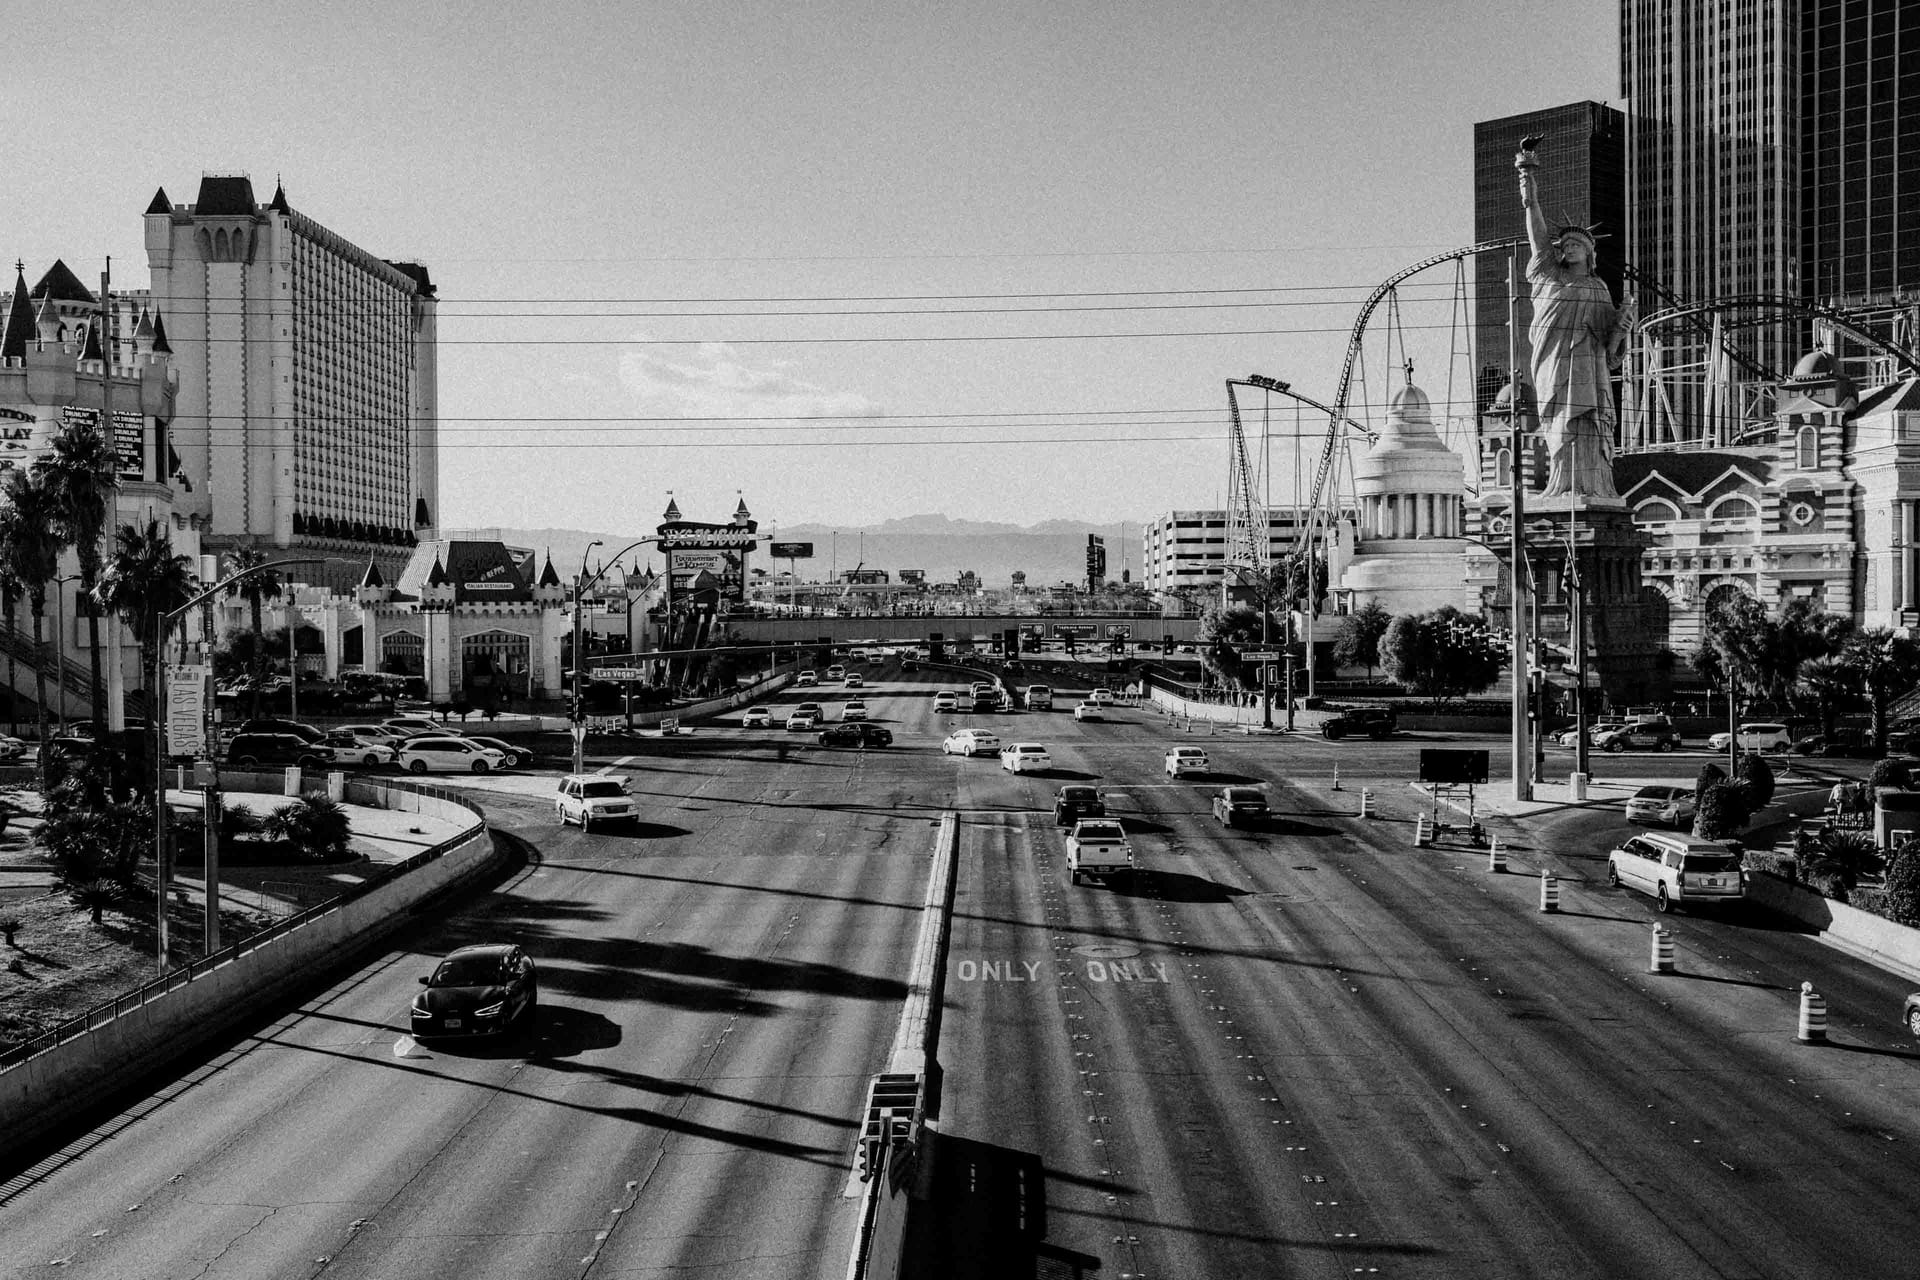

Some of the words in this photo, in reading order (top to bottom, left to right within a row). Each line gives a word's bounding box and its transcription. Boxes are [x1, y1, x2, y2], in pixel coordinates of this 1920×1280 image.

[597, 669, 611, 678] Las
[613, 669, 635, 679] Vegas
[172, 683, 198, 704] LAS
[172, 709, 199, 748] VEGAS
[957, 960, 1042, 983] ONLY
[1086, 960, 1170, 984] ONLY
